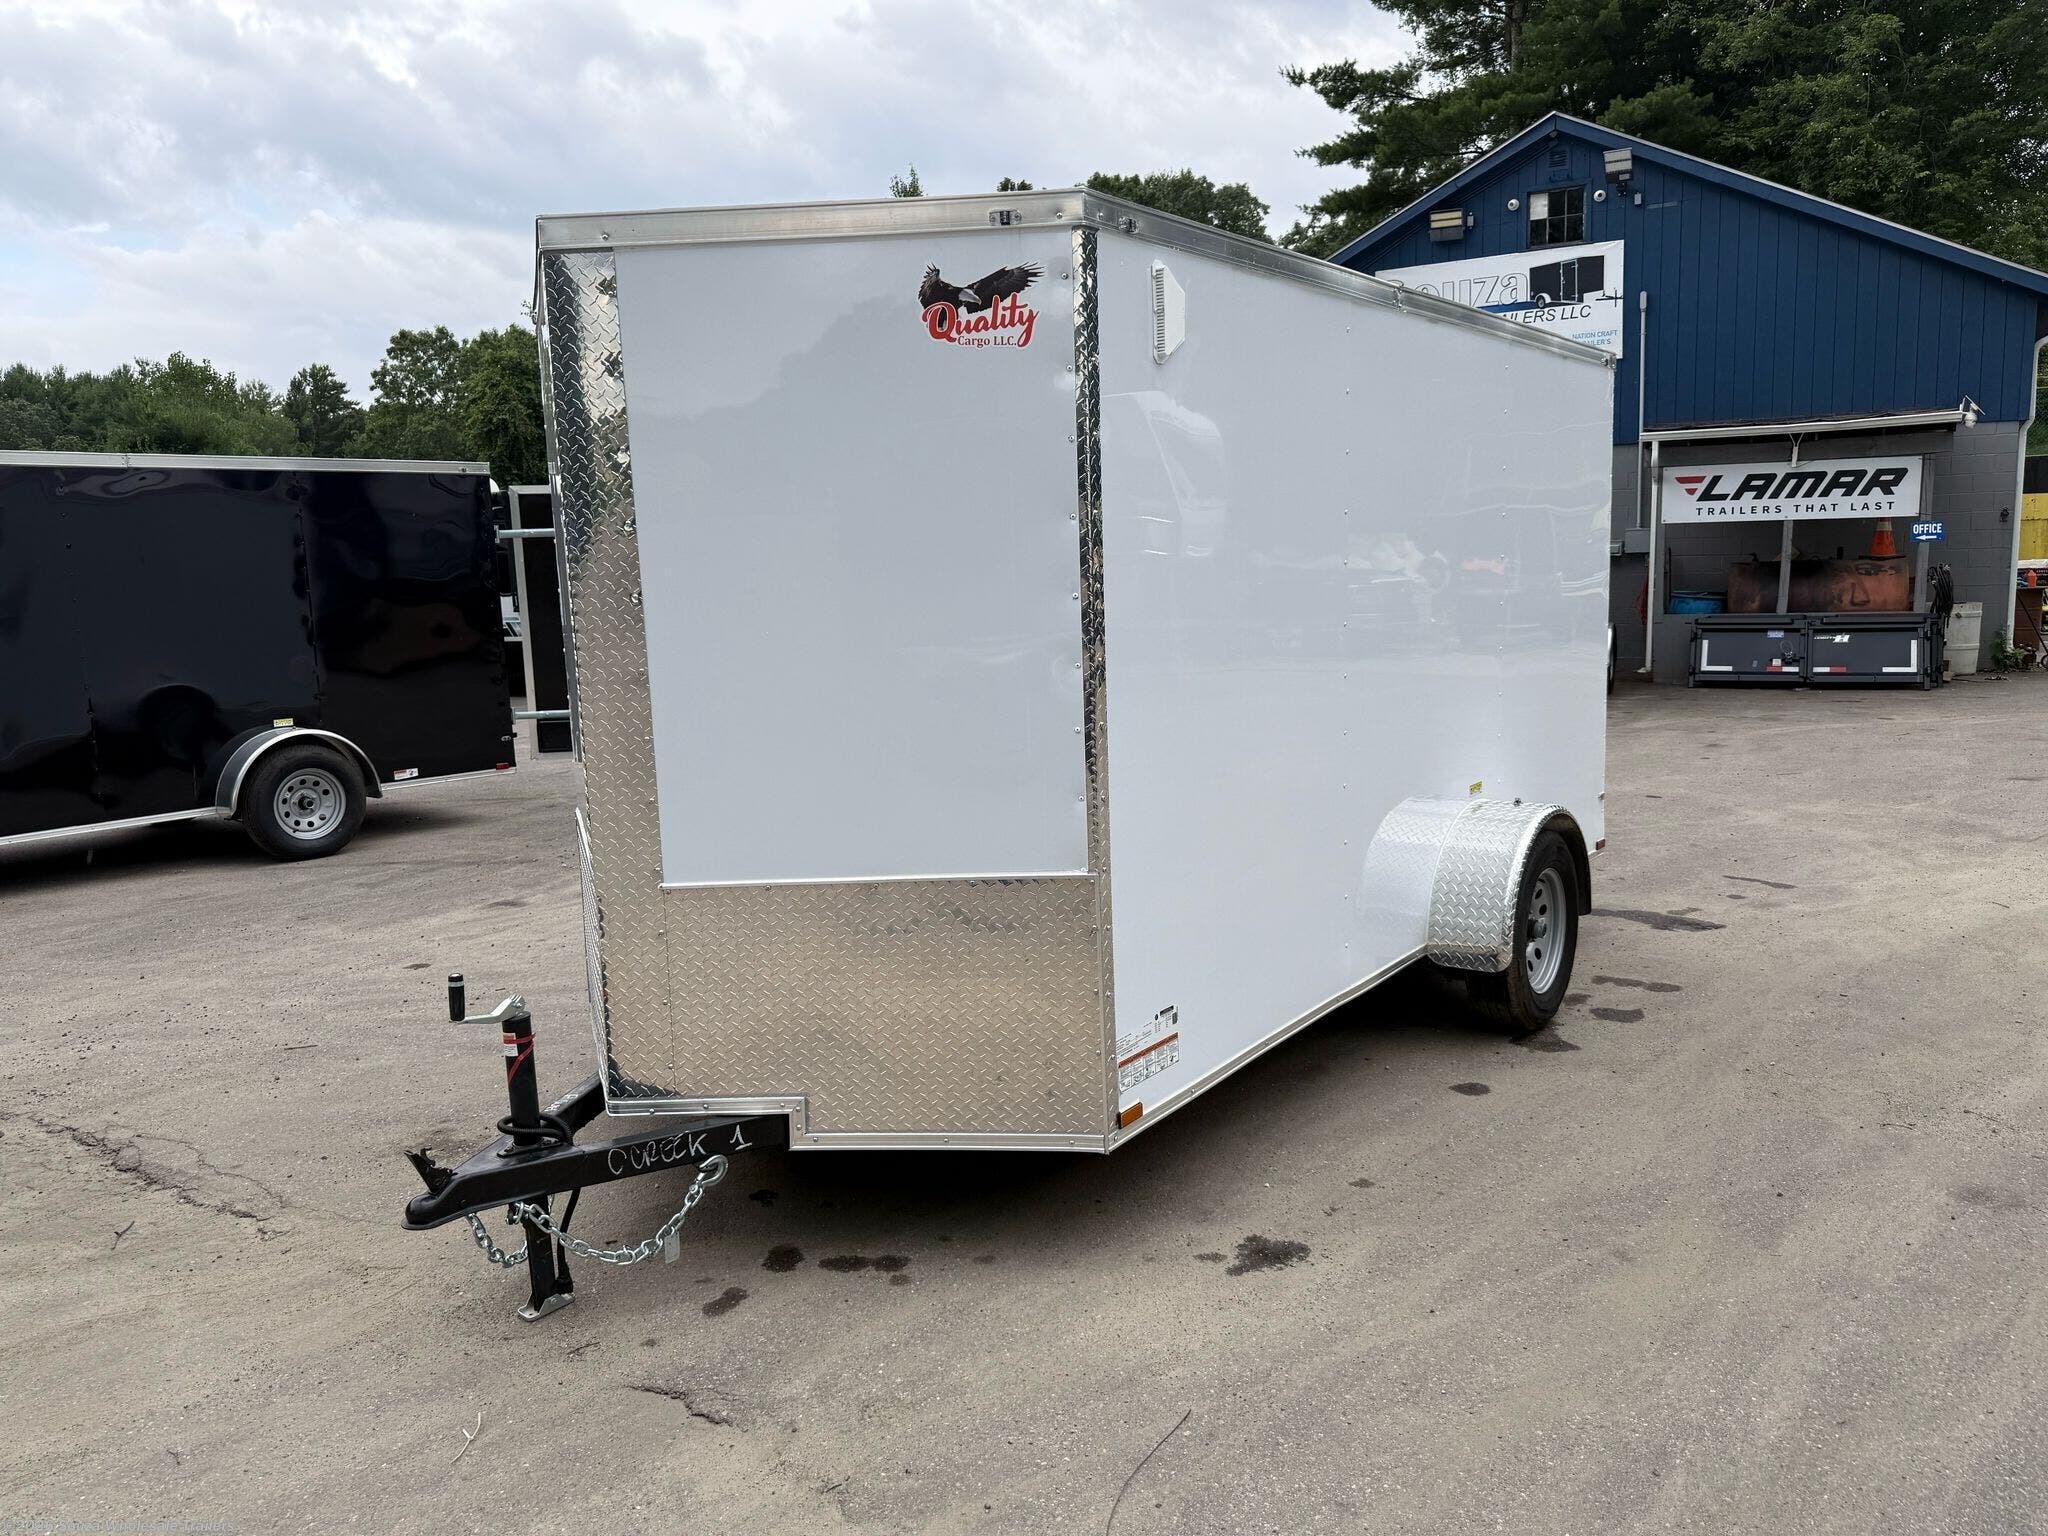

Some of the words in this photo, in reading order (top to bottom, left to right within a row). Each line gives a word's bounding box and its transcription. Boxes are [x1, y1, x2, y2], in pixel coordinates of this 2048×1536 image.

[922, 292, 1039, 348] Quality
[1561, 305, 1591, 320] LLC
[1597, 330, 1618, 338] CRAFT
[957, 336, 990, 348] Cargo
[994, 336, 1017, 346] LLC.
[1696, 467, 1909, 502] LAMAR
[1696, 504, 1782, 516] TRAILERS
[1793, 503, 1839, 513] THAT
[1850, 501, 1895, 512] LAST
[1913, 522, 1942, 534] OFFICE
